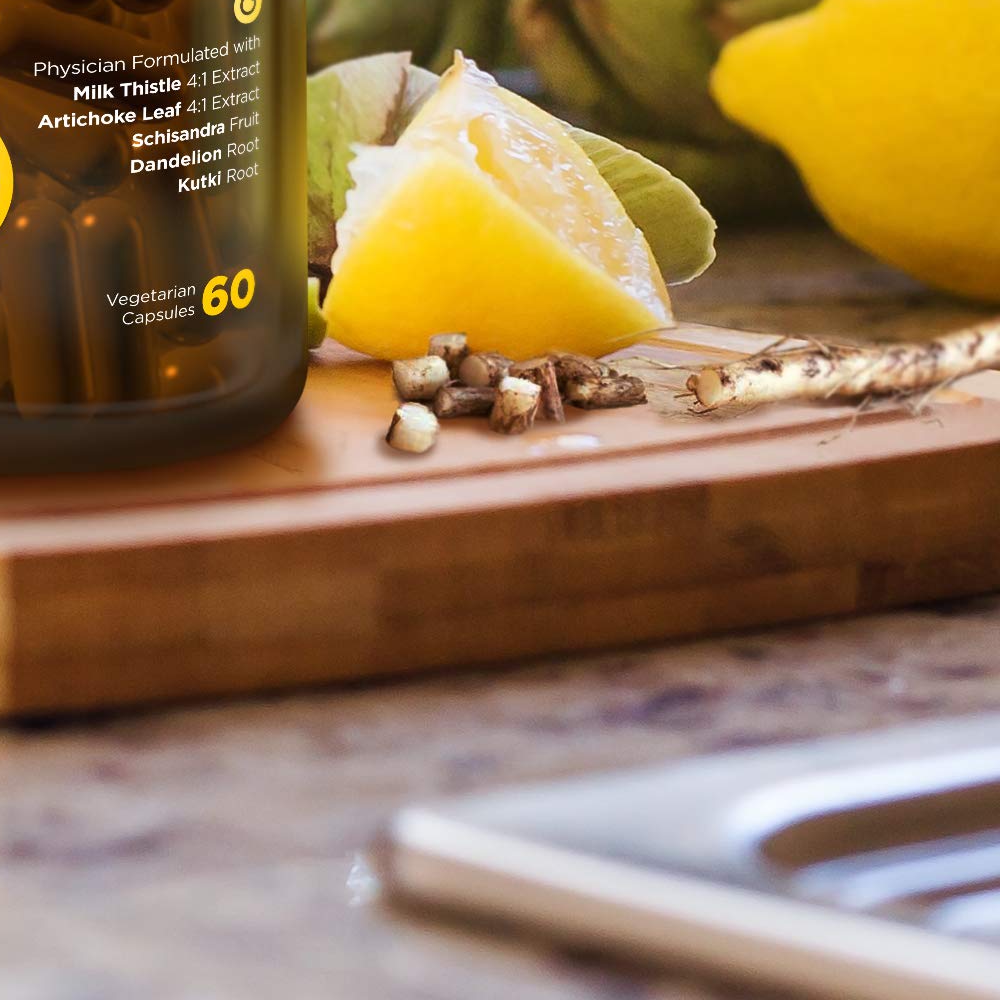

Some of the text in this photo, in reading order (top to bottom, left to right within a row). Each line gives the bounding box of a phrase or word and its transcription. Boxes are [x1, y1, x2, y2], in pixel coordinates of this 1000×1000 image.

[33, 35, 261, 79] Physician Formulated with
[73, 60, 261, 101] Milk Thistle 4:1 Extract
[37, 86, 261, 130] Artichoke Leaf 4:1 Extract
[131, 112, 260, 148] Schisandra Fruit
[130, 137, 260, 174] Dandelion Root
[178, 162, 259, 193] Kutki Root
[106, 283, 197, 308] Vegetarian
[201, 267, 256, 316] 60
[121, 304, 196, 327] Capsules
